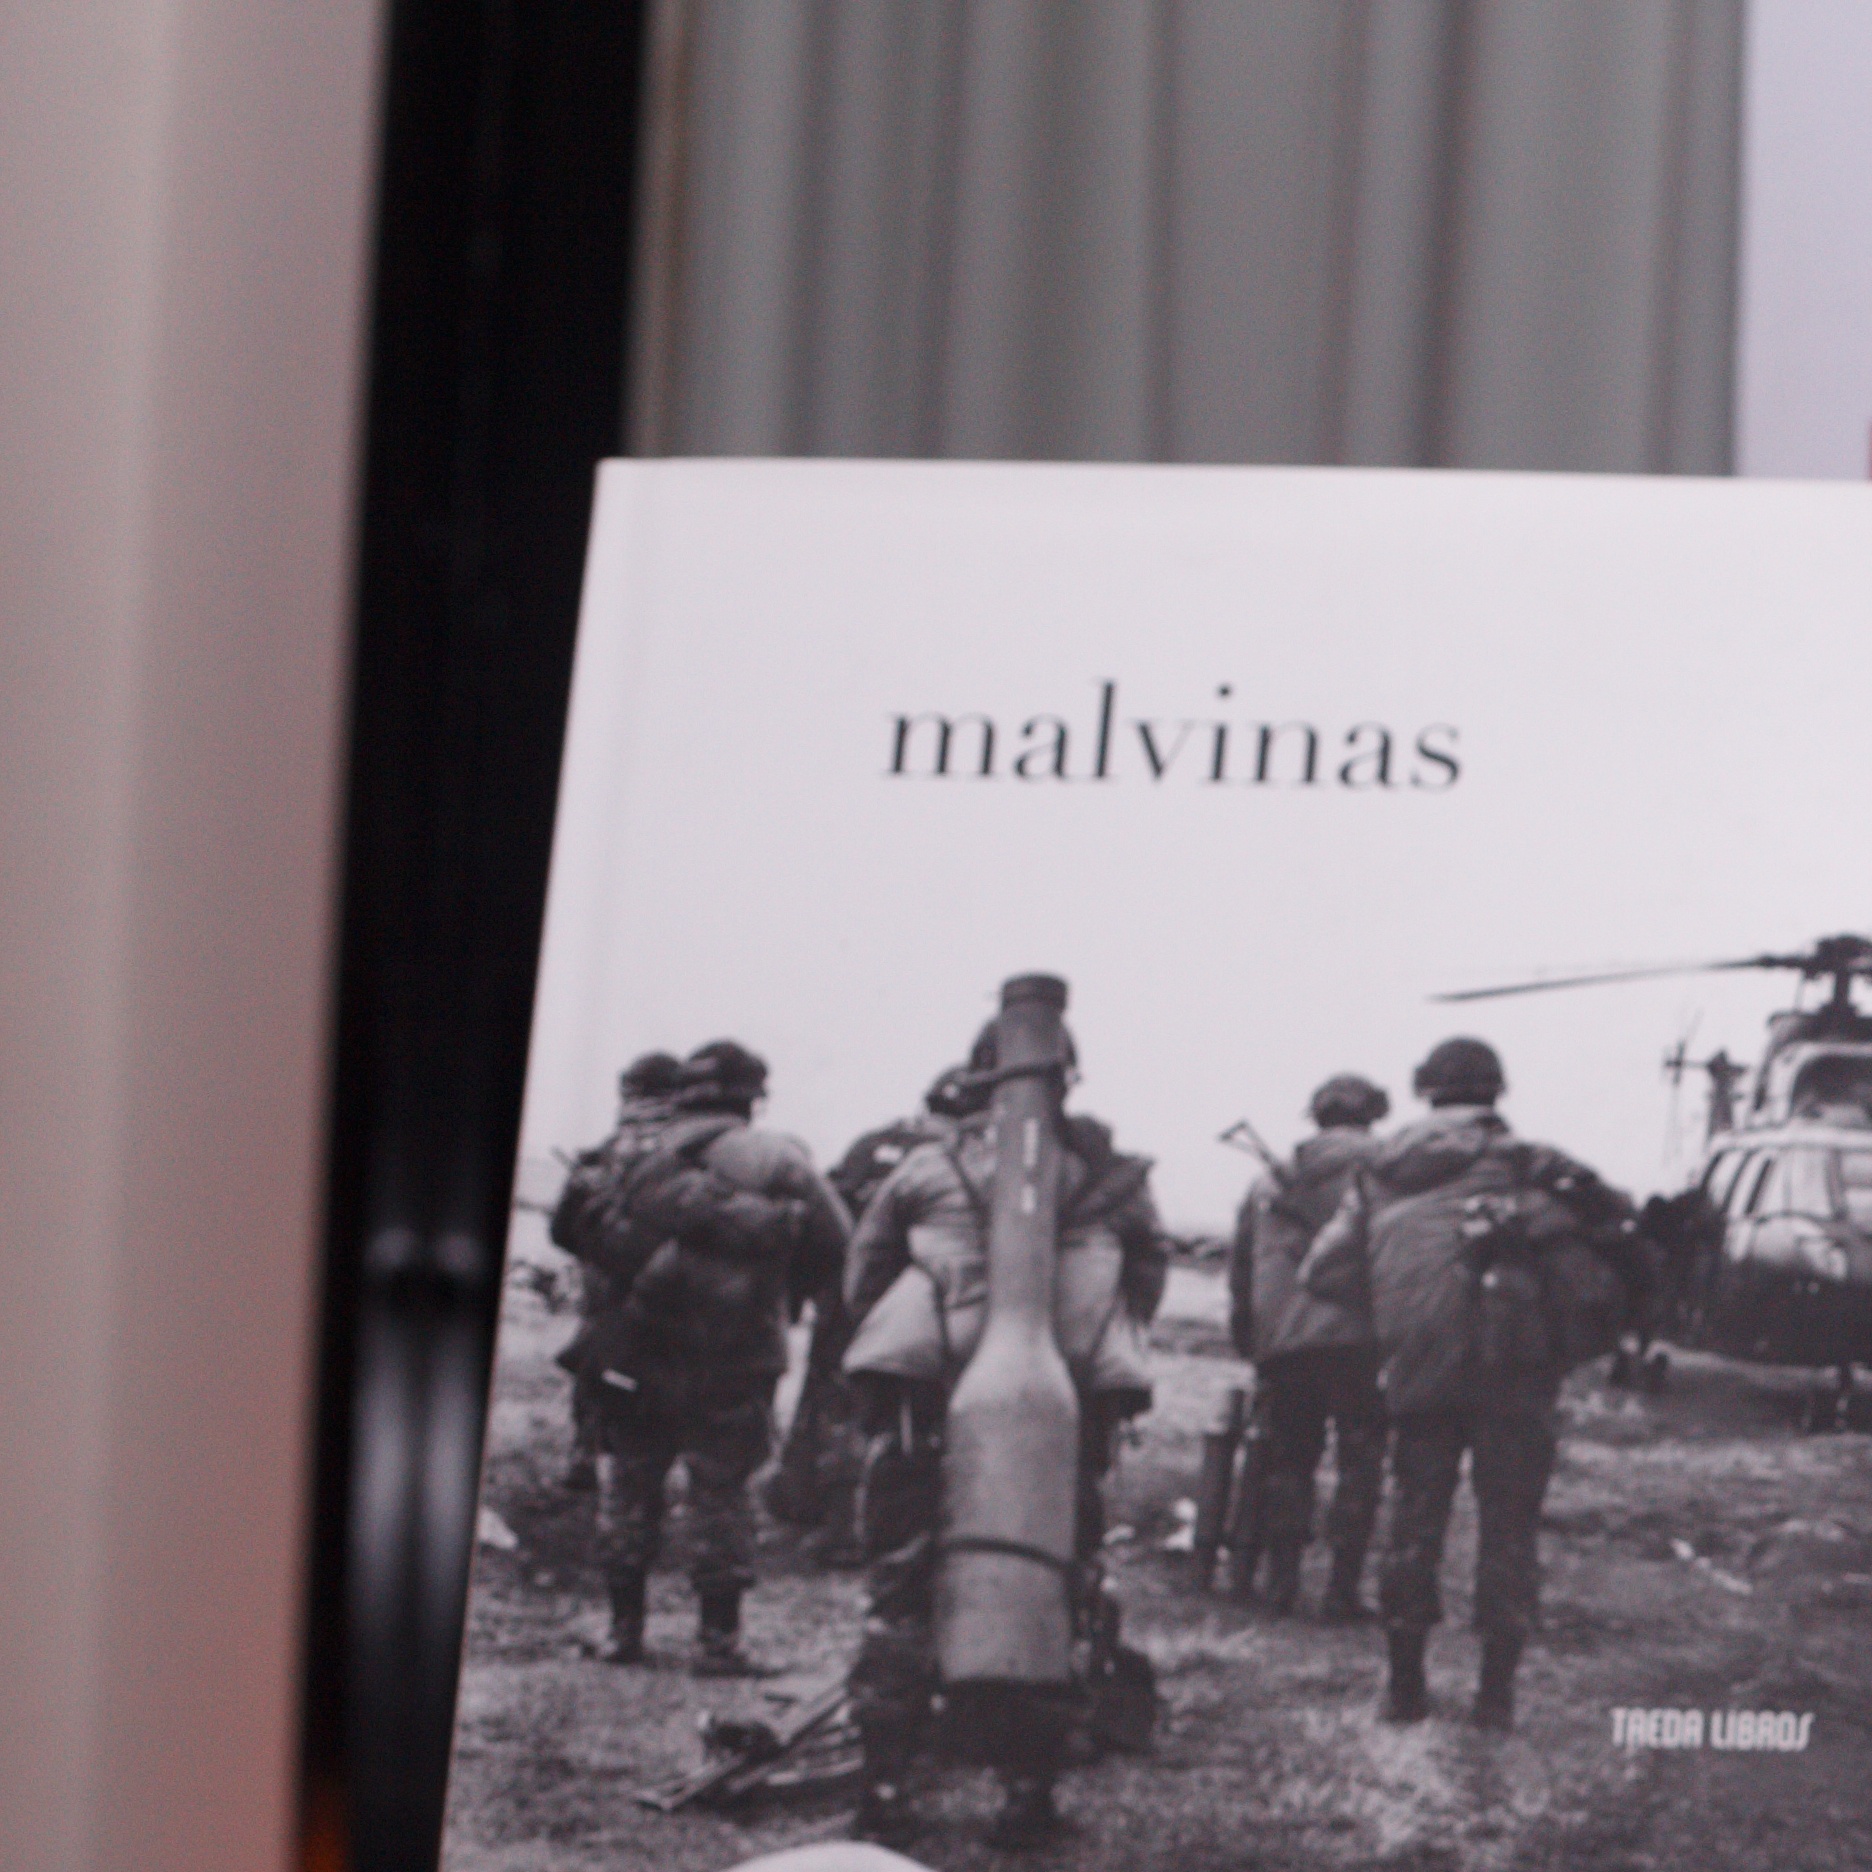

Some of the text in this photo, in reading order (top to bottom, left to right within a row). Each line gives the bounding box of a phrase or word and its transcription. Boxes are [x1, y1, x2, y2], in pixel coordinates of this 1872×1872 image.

[881, 676, 1463, 792] malvinas
[1610, 1706, 1817, 1753] TAEDA LIBROS
